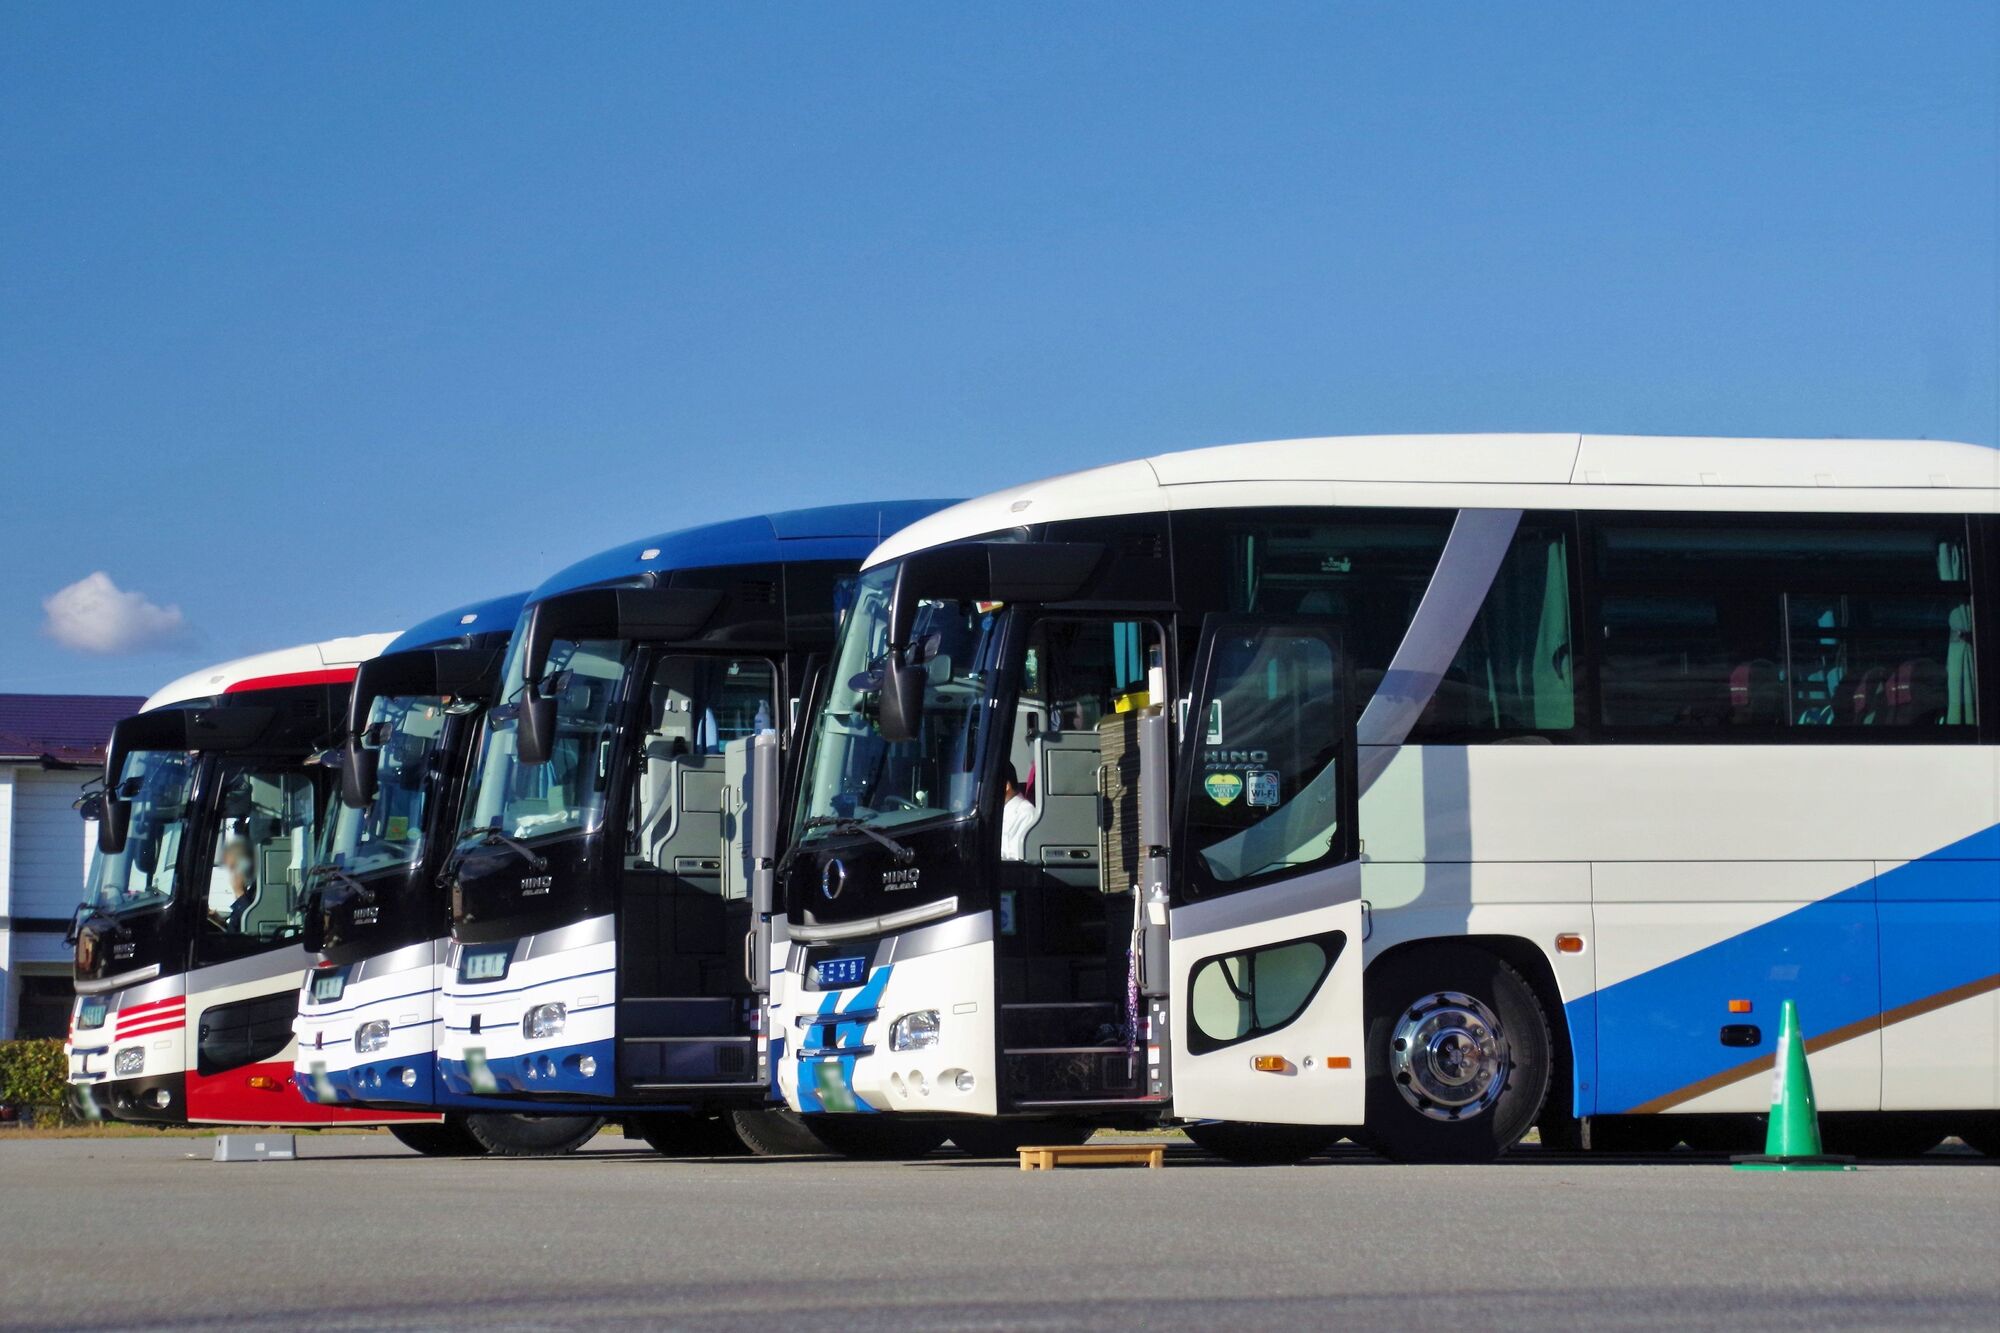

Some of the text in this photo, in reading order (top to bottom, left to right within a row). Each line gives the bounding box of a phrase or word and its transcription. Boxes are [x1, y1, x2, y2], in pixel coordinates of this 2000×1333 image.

[1204, 750, 1268, 763] HINO
[1251, 788, 1276, 798] Wi-Fi
[882, 868, 920, 884] HINO
